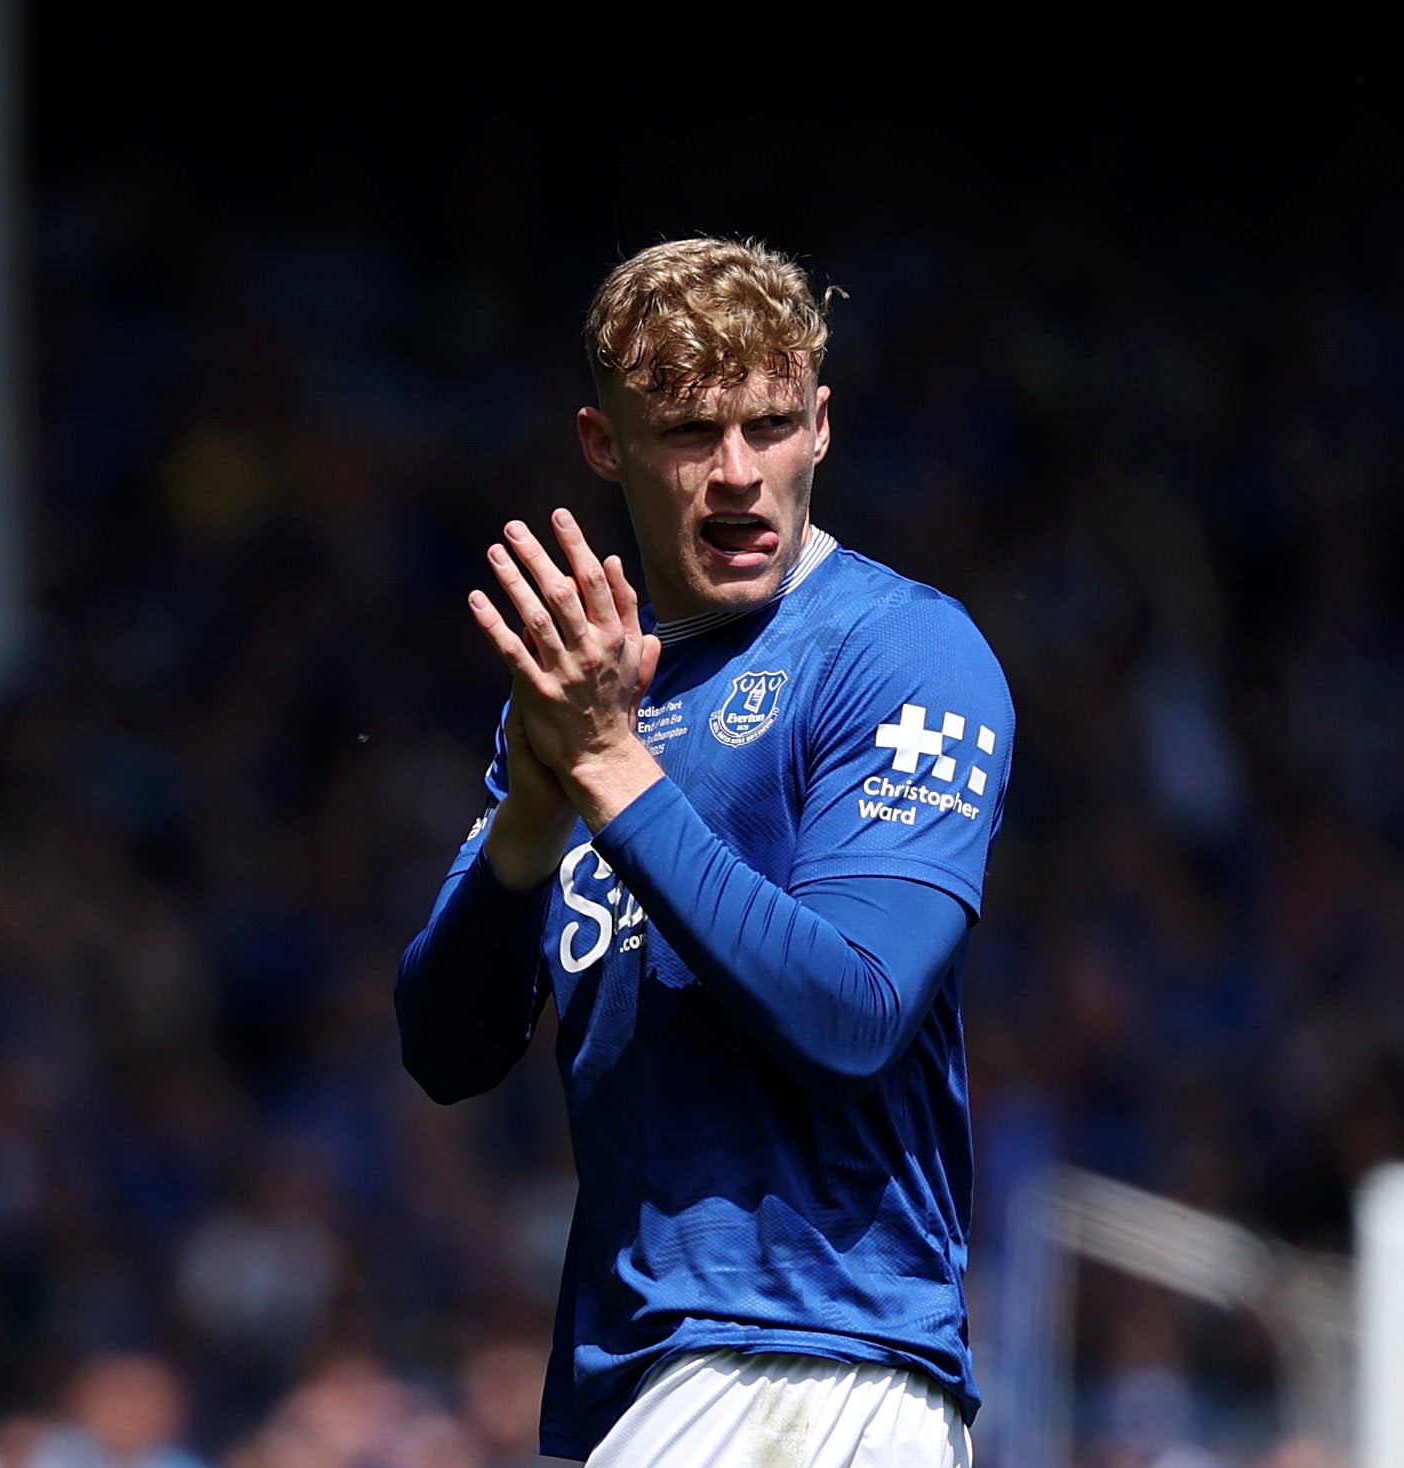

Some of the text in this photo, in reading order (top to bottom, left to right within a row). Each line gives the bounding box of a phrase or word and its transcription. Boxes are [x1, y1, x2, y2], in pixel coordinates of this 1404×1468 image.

[726, 712, 766, 723] Everton
[863, 776, 980, 820] Christopher
[858, 799, 917, 826] Ward
